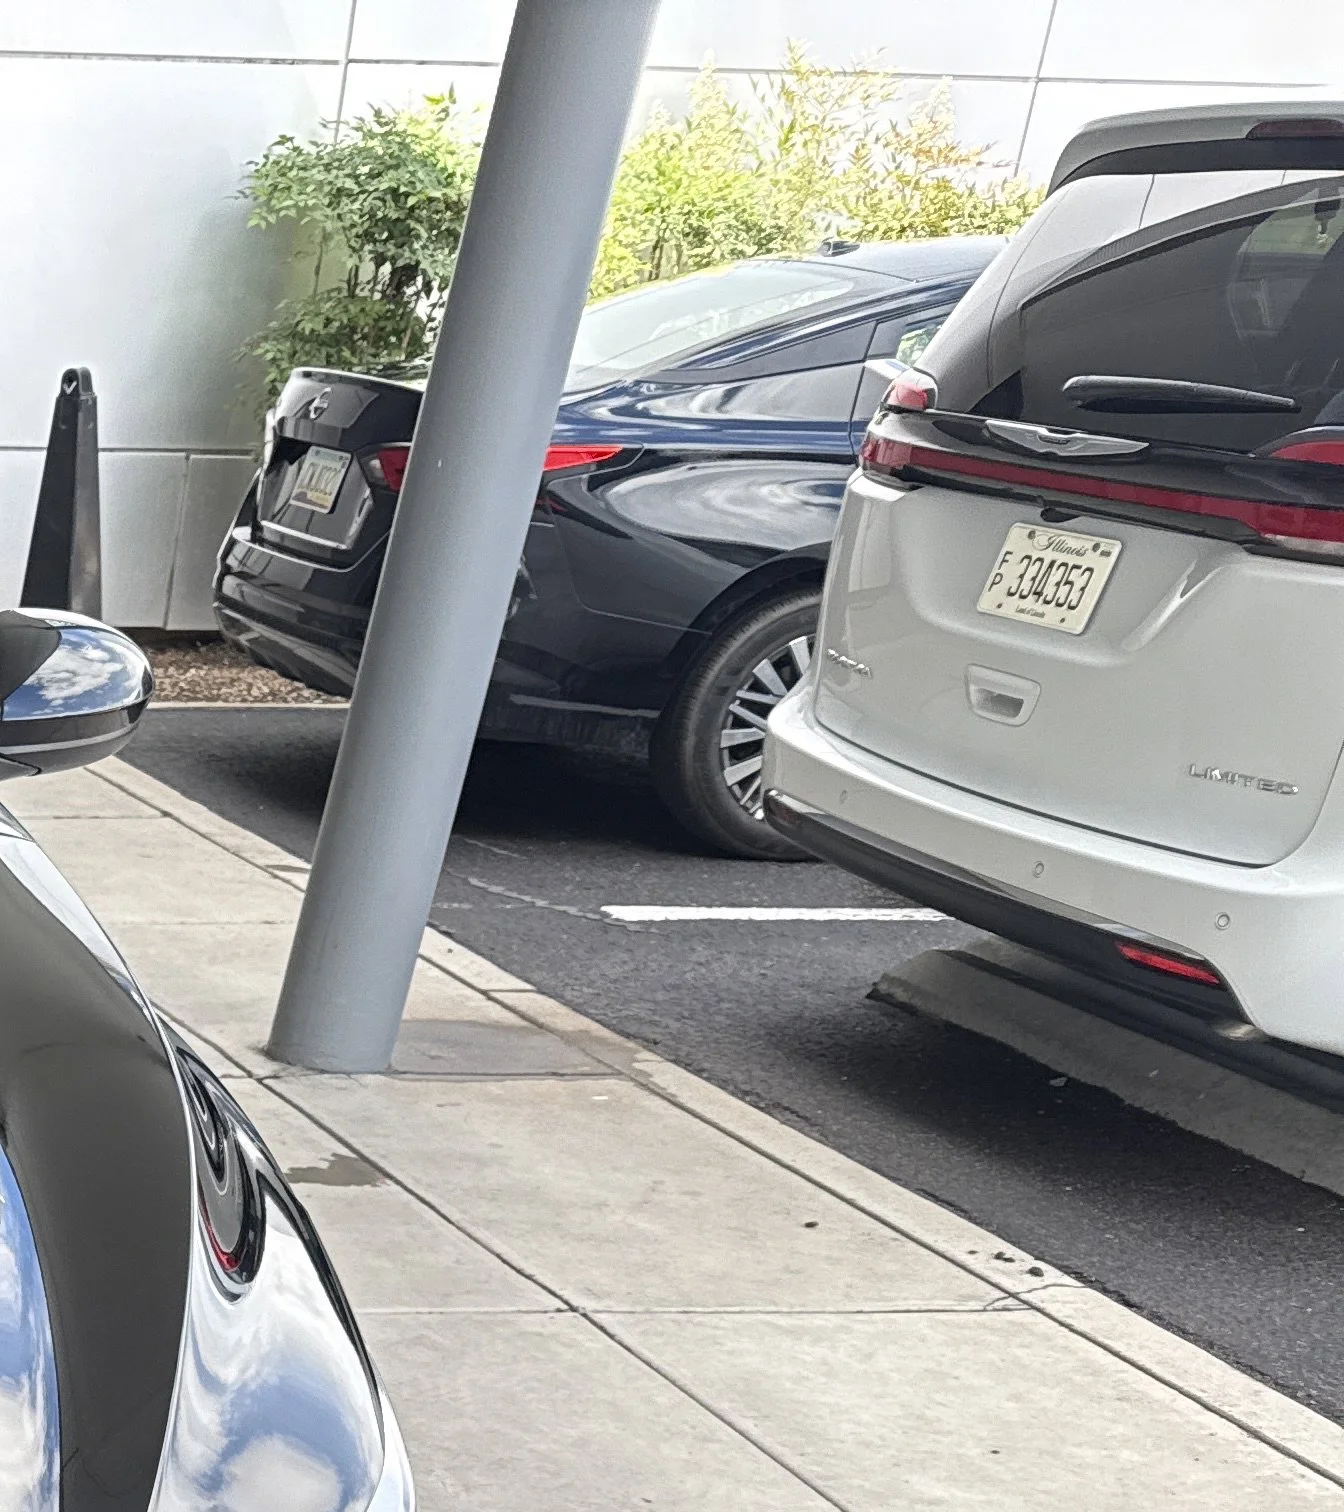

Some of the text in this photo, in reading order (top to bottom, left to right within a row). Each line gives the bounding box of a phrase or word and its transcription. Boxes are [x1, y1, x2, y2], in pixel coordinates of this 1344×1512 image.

[1032, 533, 1089, 558] Illinois
[1006, 554, 1095, 611] 334353
[1189, 763, 1299, 796] LIMITED
